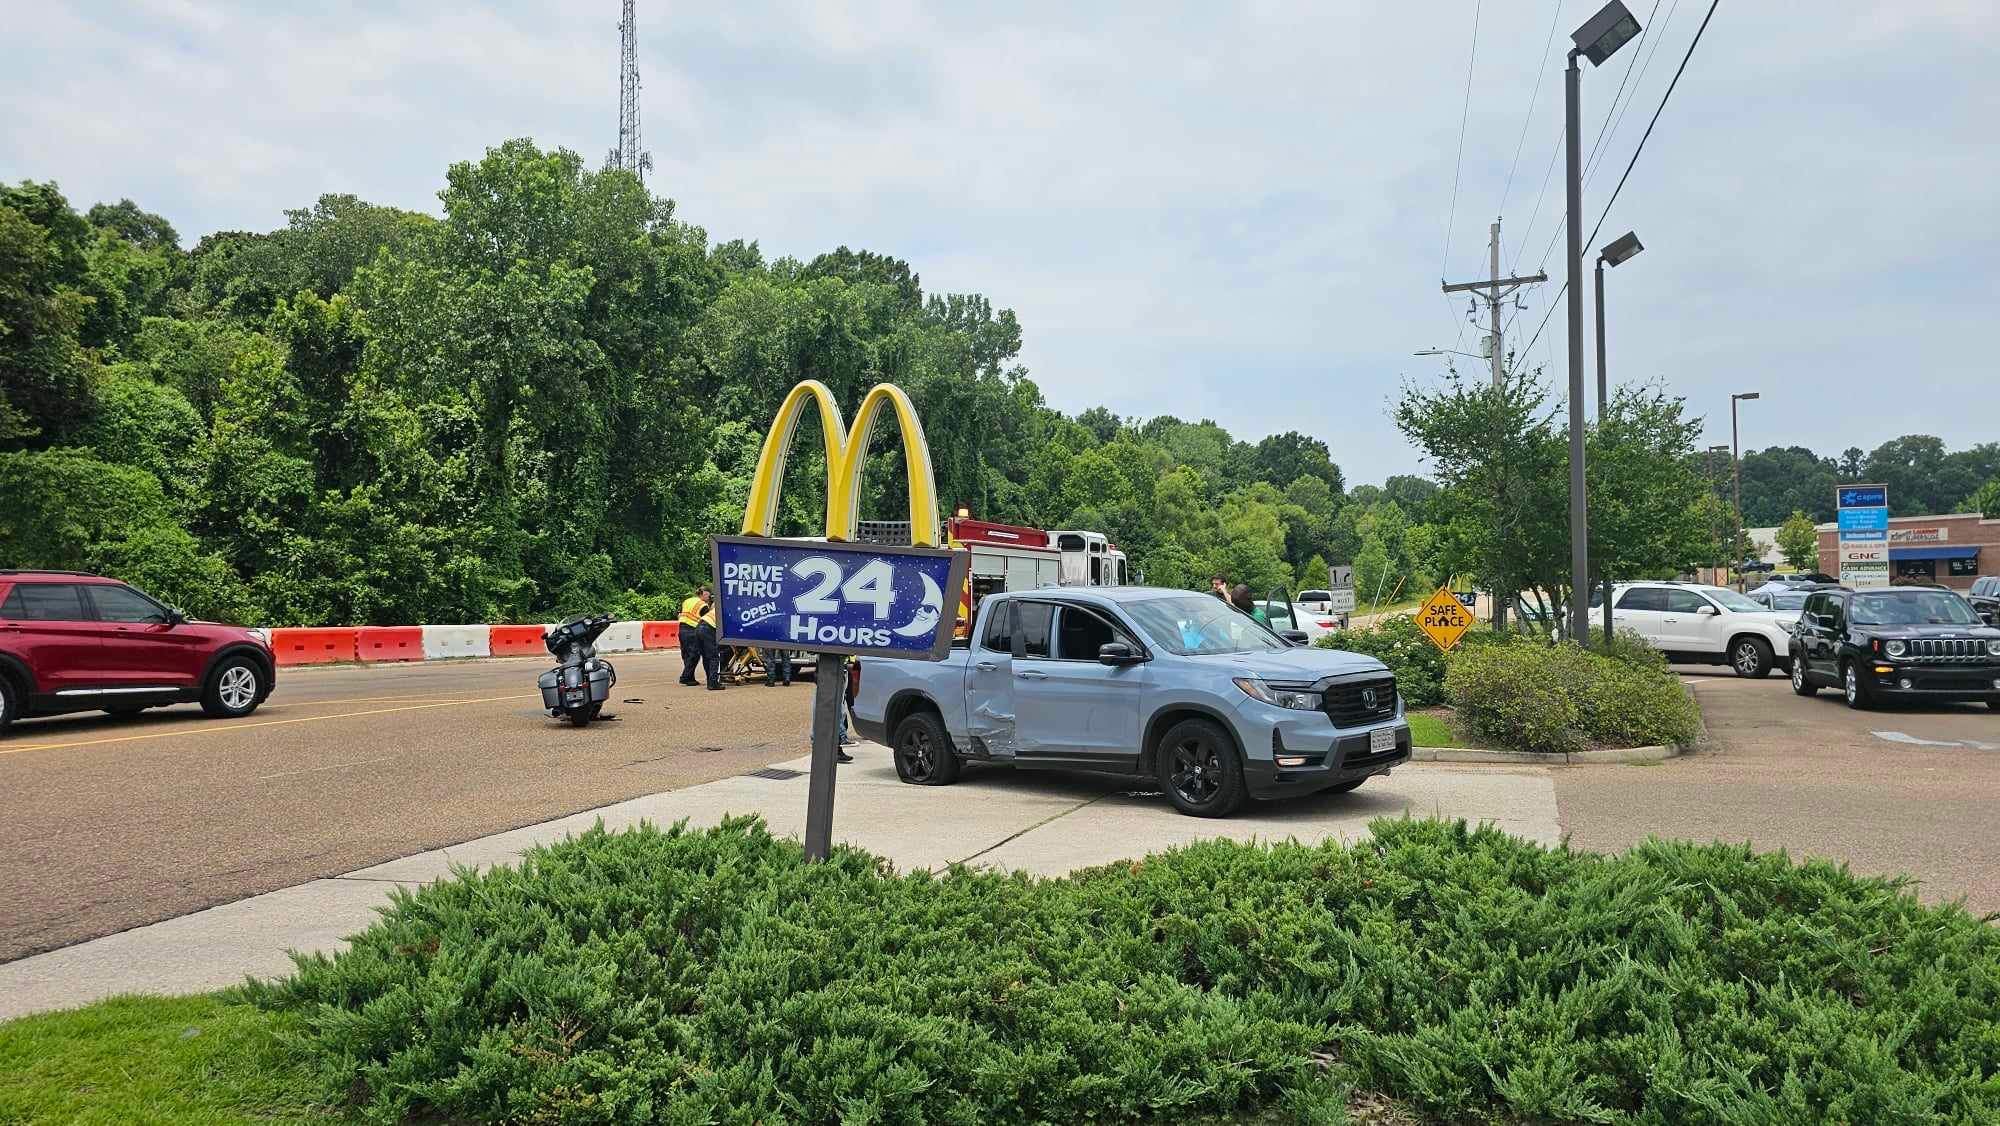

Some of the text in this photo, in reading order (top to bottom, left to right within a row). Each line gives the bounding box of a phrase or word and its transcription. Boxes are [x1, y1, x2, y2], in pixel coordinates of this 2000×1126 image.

[1848, 552, 1880, 560] GNC
[723, 562, 784, 582] DRIVE
[724, 579, 782, 598] THRU
[790, 555, 898, 621] 24
[740, 601, 777, 622] OPEN
[1430, 605, 1457, 616] SAFE
[790, 614, 892, 647] HOURS
